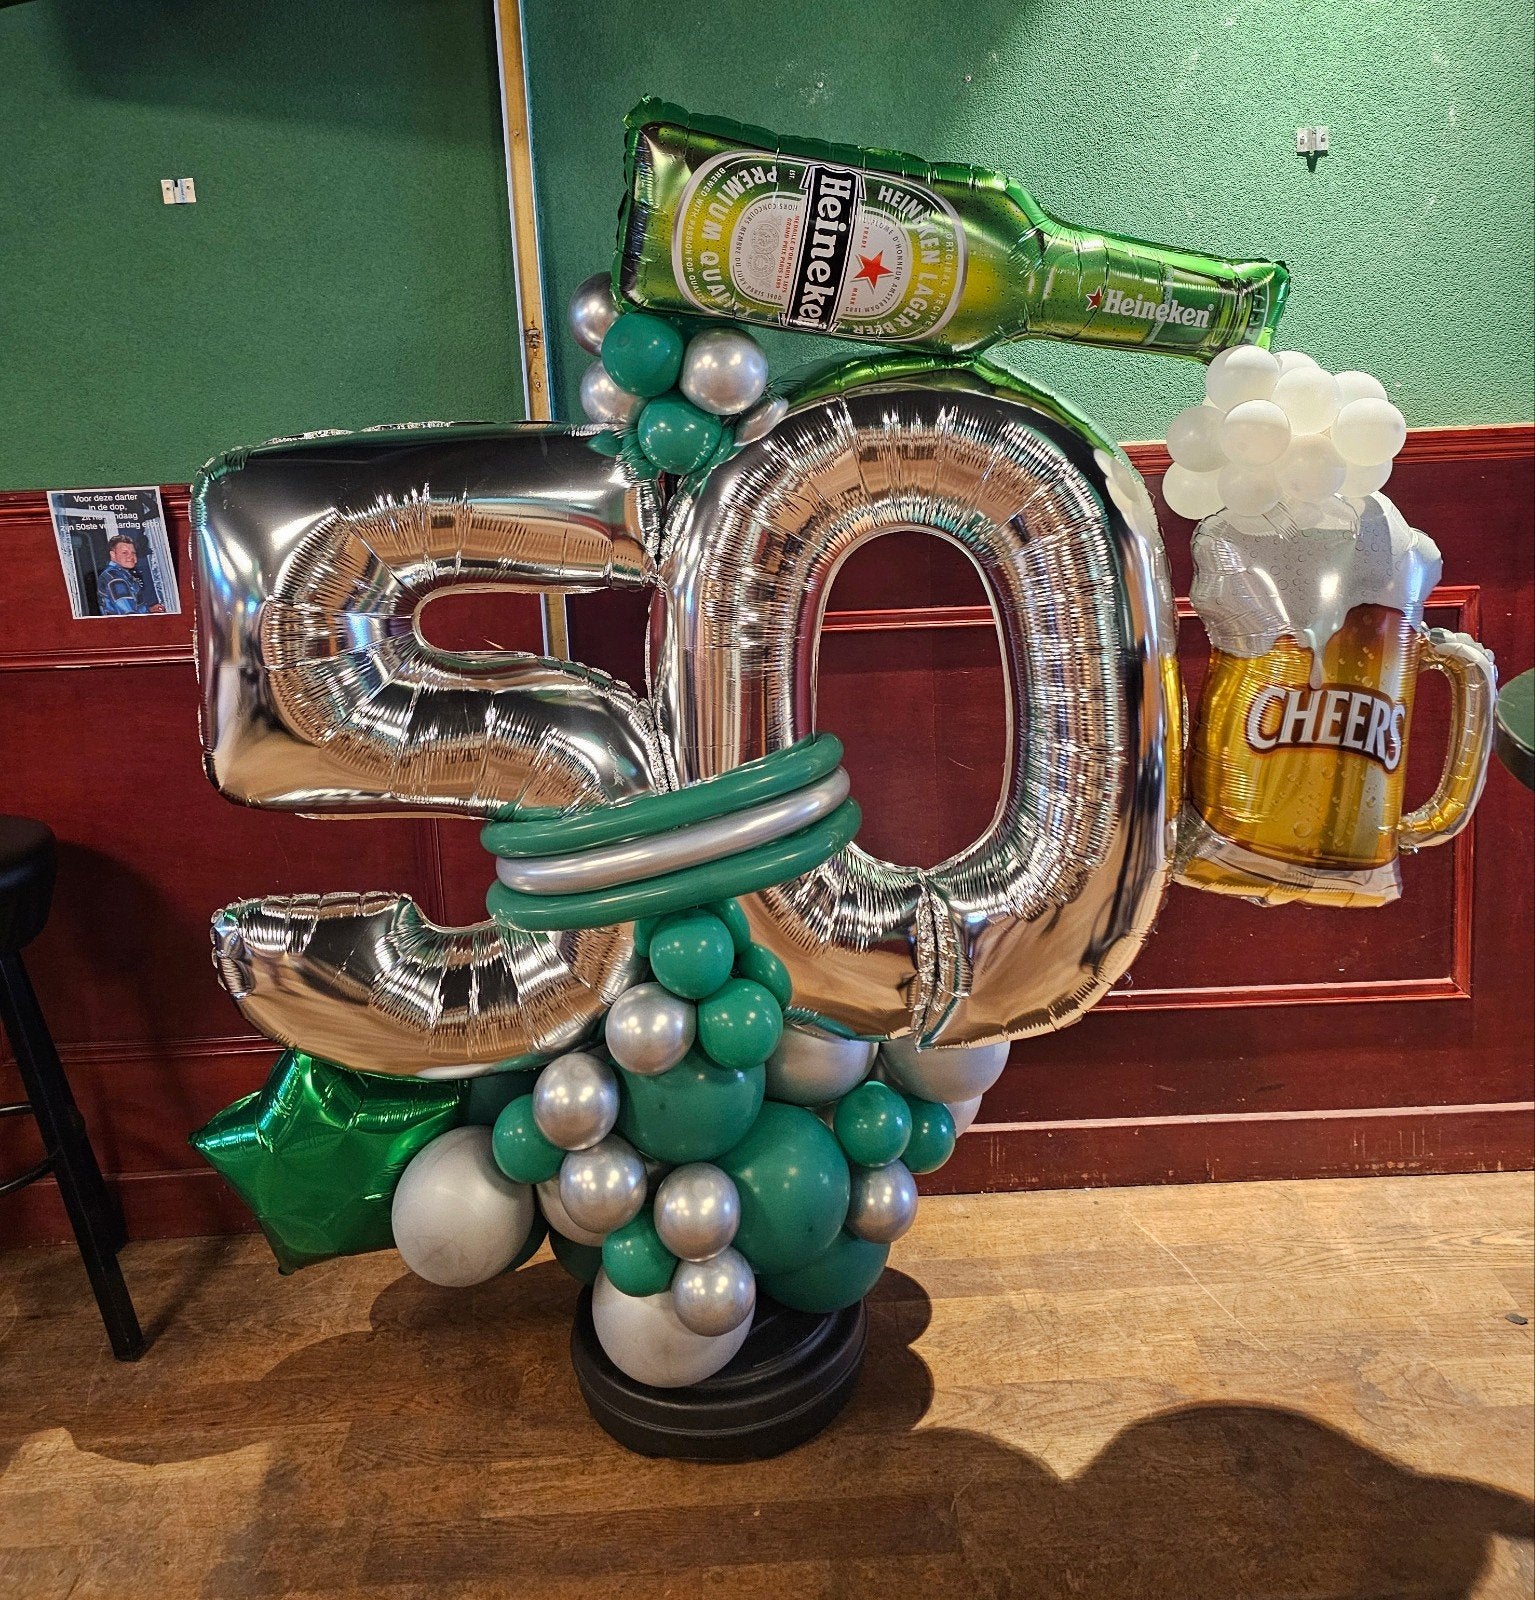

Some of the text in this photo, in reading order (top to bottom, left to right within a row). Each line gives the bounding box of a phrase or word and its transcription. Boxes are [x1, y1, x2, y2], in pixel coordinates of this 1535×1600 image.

[701, 167, 726, 197] BREWED
[701, 166, 778, 240] PREMIUM
[746, 203, 777, 225] CONCOURS
[784, 217, 792, 239] GRAND
[734, 226, 747, 256] MEMBRE
[686, 257, 694, 272] FOR
[734, 257, 742, 268] DU
[745, 285, 765, 298] PARIS
[766, 293, 782, 301] 1900
[893, 272, 935, 328] LAGER
[925, 292, 946, 326] RECIPE
[1102, 289, 1210, 328] Heineken
[73, 493, 138, 503] Voor deze darter
[97, 503, 108, 511] de
[75, 522, 98, 531] 50ste
[1247, 685, 1406, 771] CHEERS
